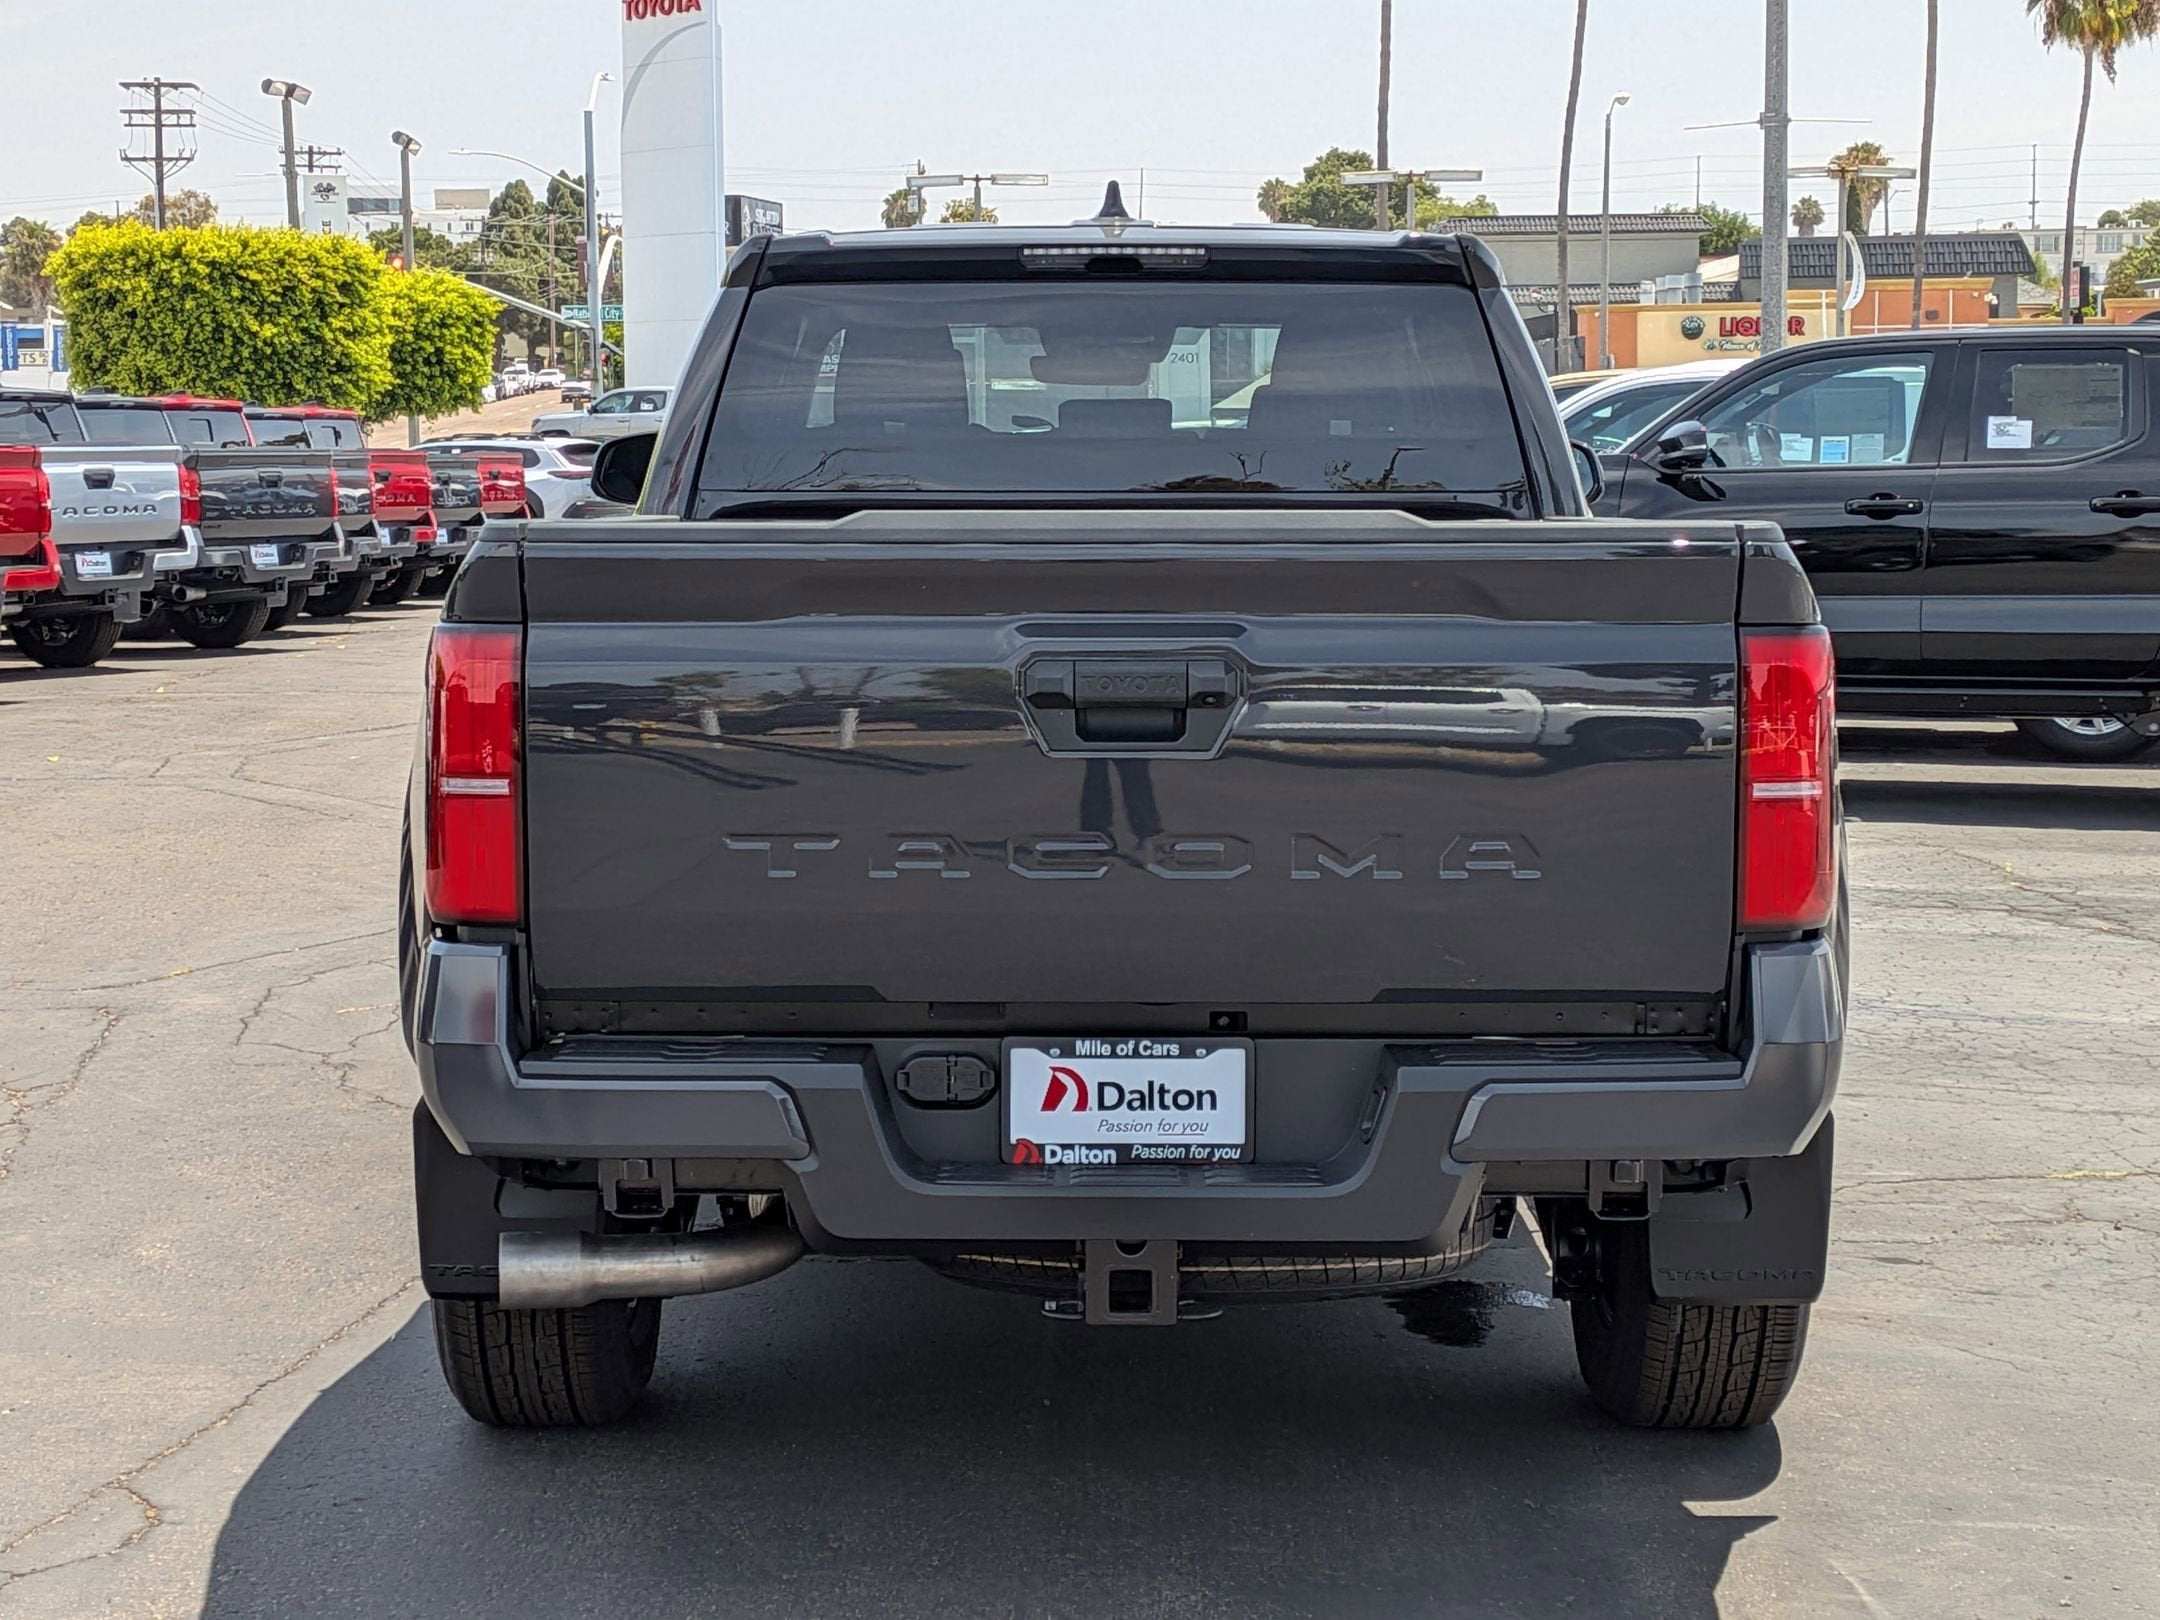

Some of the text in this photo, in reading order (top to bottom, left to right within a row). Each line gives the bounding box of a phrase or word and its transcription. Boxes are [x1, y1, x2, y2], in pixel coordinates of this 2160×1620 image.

[622, 0, 702, 22] TOYOTA
[1719, 315, 1806, 338] LIQR
[1170, 352, 1199, 364] 2401
[1079, 675, 1182, 694] TOYOTA
[722, 832, 1541, 880] TACOMA
[1075, 1040, 1180, 1056] Mile of Cars
[1097, 1080, 1217, 1111] Dalton
[1097, 1118, 1209, 1136] Passion for you
[1044, 1145, 1117, 1164] Dalton
[1130, 1145, 1241, 1162] Passion for you
[427, 1263, 500, 1278] TAC
